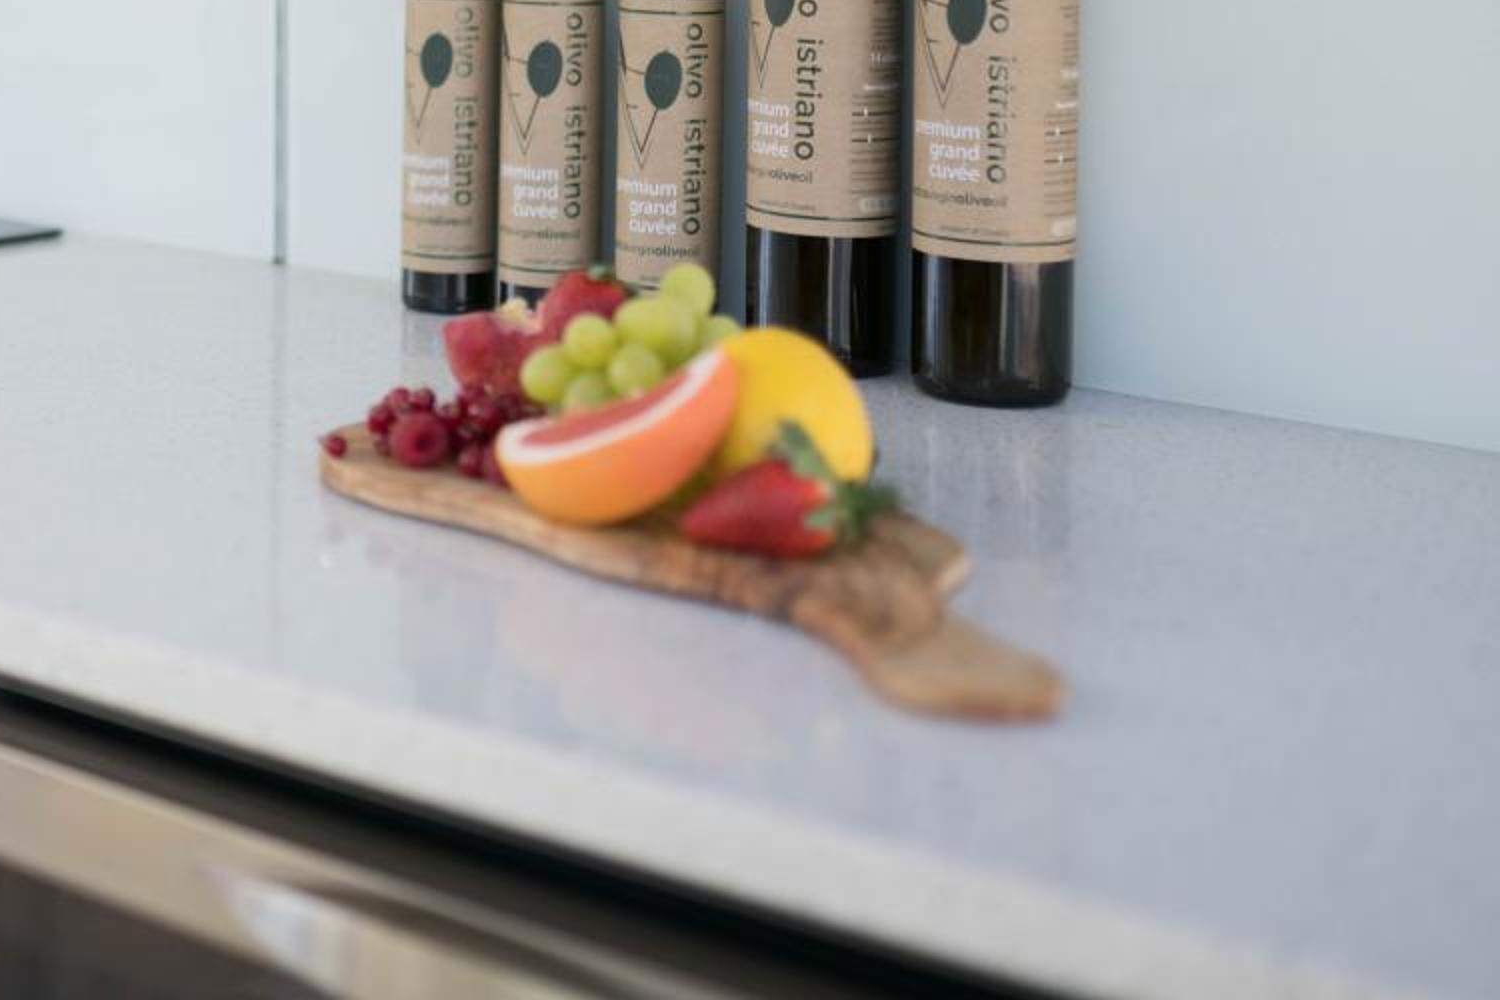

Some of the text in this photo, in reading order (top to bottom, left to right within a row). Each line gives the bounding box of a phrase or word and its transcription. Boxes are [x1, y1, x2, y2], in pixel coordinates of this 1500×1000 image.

[453, 6, 479, 207] olivo istriano
[794, 38, 824, 160] istriano
[563, 12, 587, 219] olivo istriano
[986, 56, 1017, 183] istriano
[682, 23, 708, 235] olivo istriano
[931, 144, 980, 163] grand
[930, 164, 980, 183] cuvée
[513, 182, 559, 203] grand
[513, 199, 559, 219] cuvée
[628, 199, 677, 218] grand
[628, 217, 677, 236] cuvée
